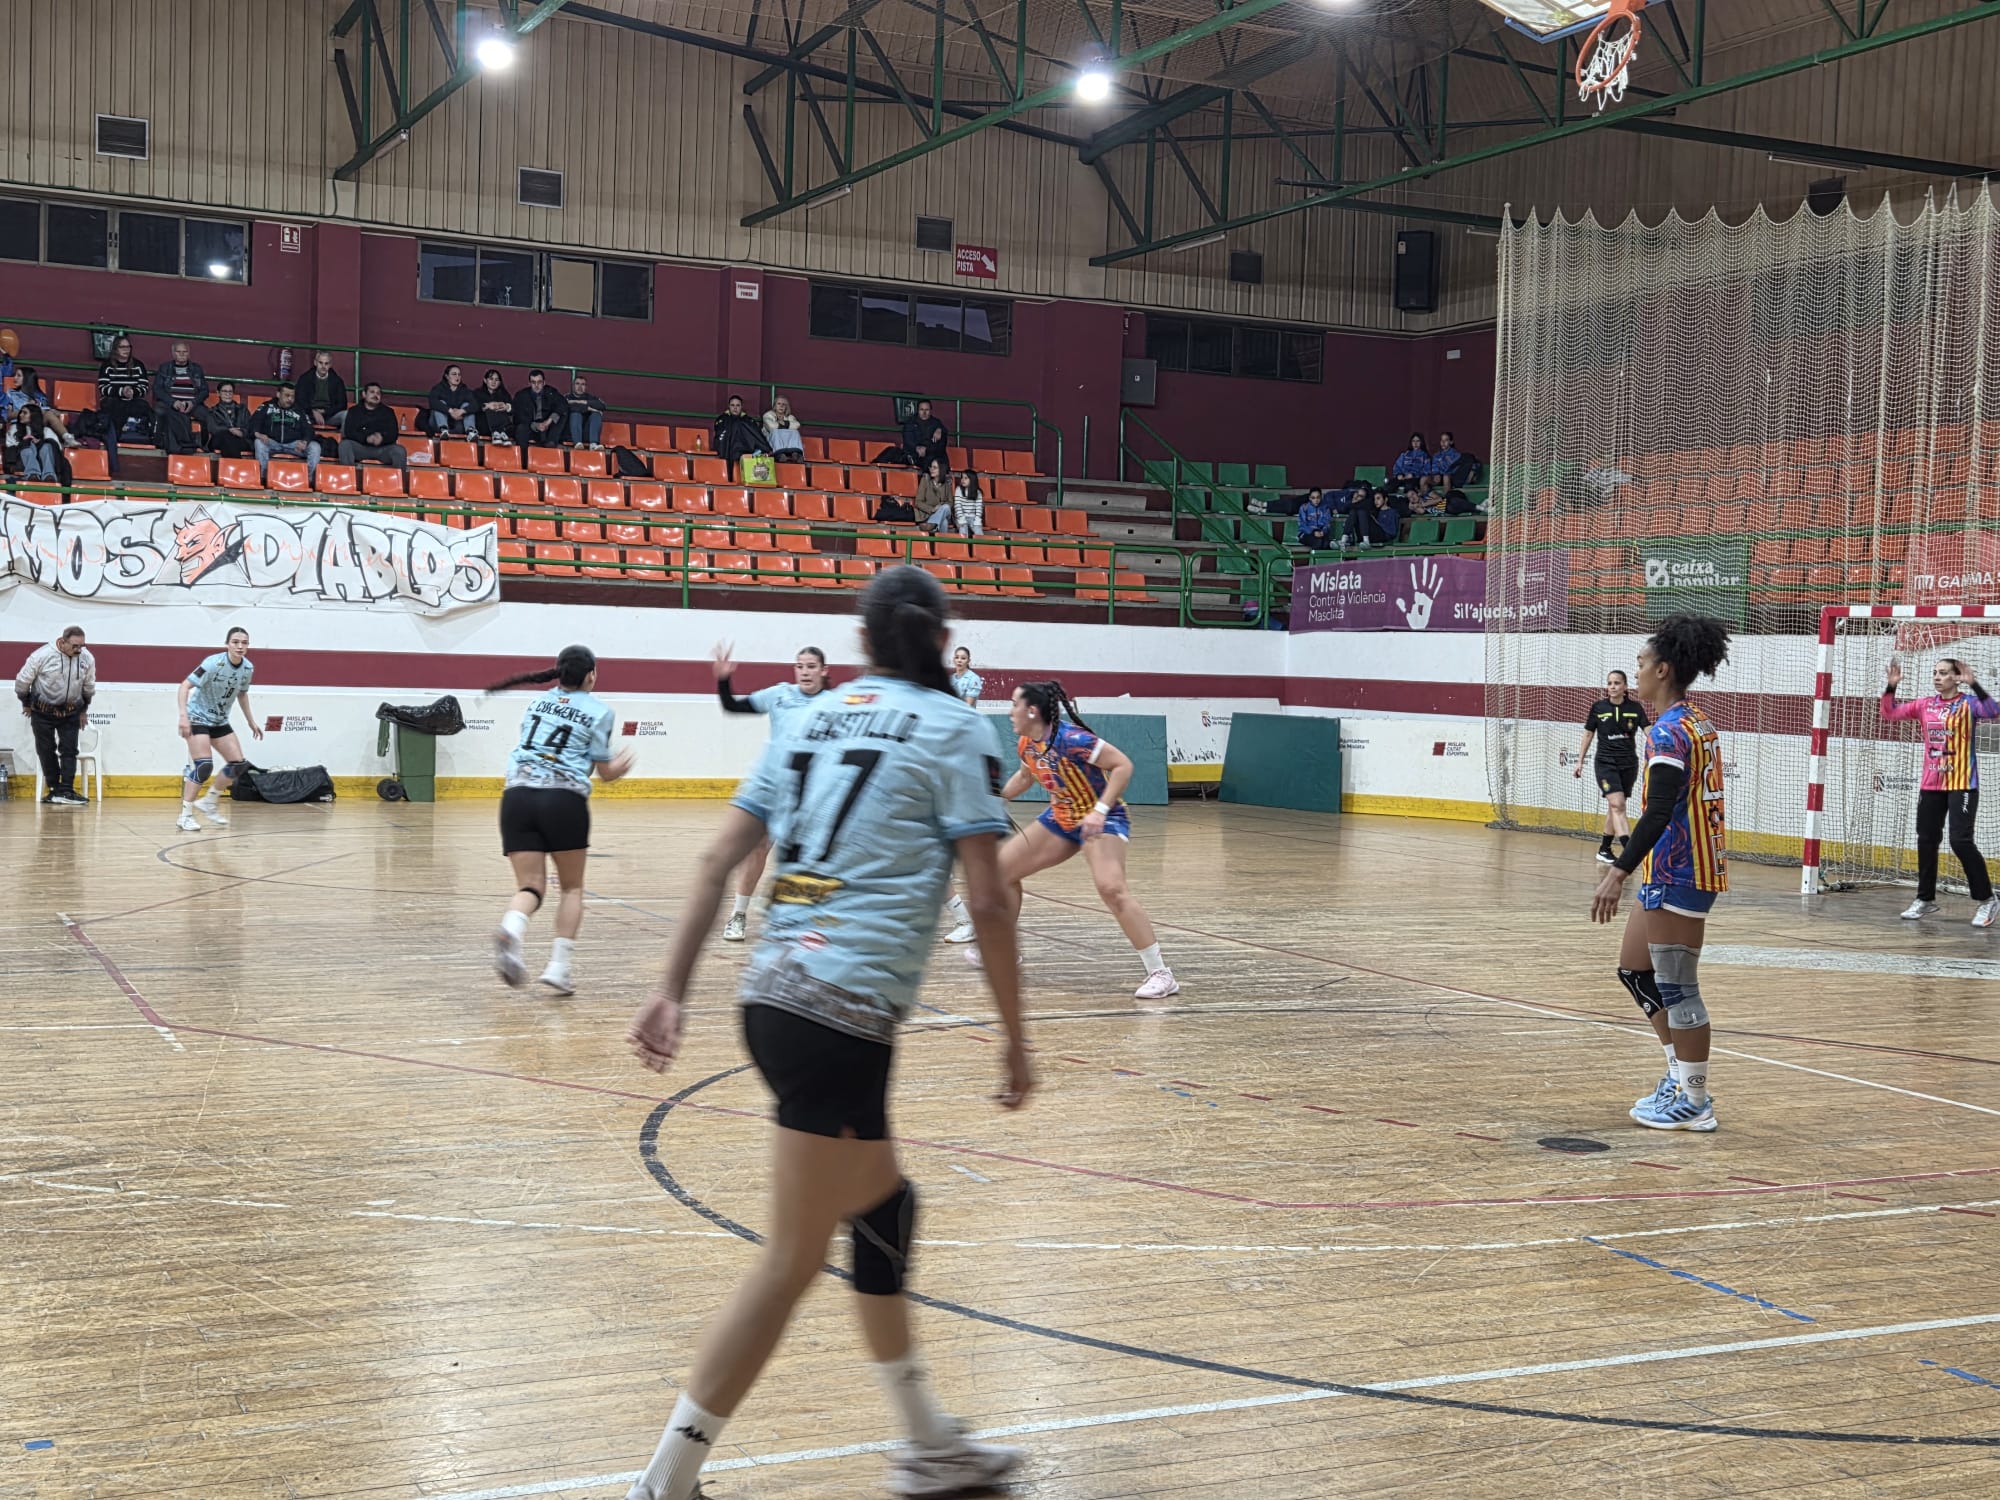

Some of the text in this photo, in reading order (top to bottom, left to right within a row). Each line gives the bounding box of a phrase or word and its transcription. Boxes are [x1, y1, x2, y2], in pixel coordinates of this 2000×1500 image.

[957, 248, 981, 261] ACCESO
[956, 261, 974, 272] PISTA
[0, 502, 497, 608] MOS DIABLOS
[1672, 560, 1714, 575] caixa
[1310, 570, 1362, 593] Mislata
[1938, 571, 1995, 589] GAMMA
[1347, 588, 1386, 604] Violència
[1454, 603, 1464, 619] Si
[1520, 600, 1549, 617] pot!
[1937, 707, 1951, 720] 12
[520, 713, 574, 755] 14
[778, 749, 884, 863] 17
